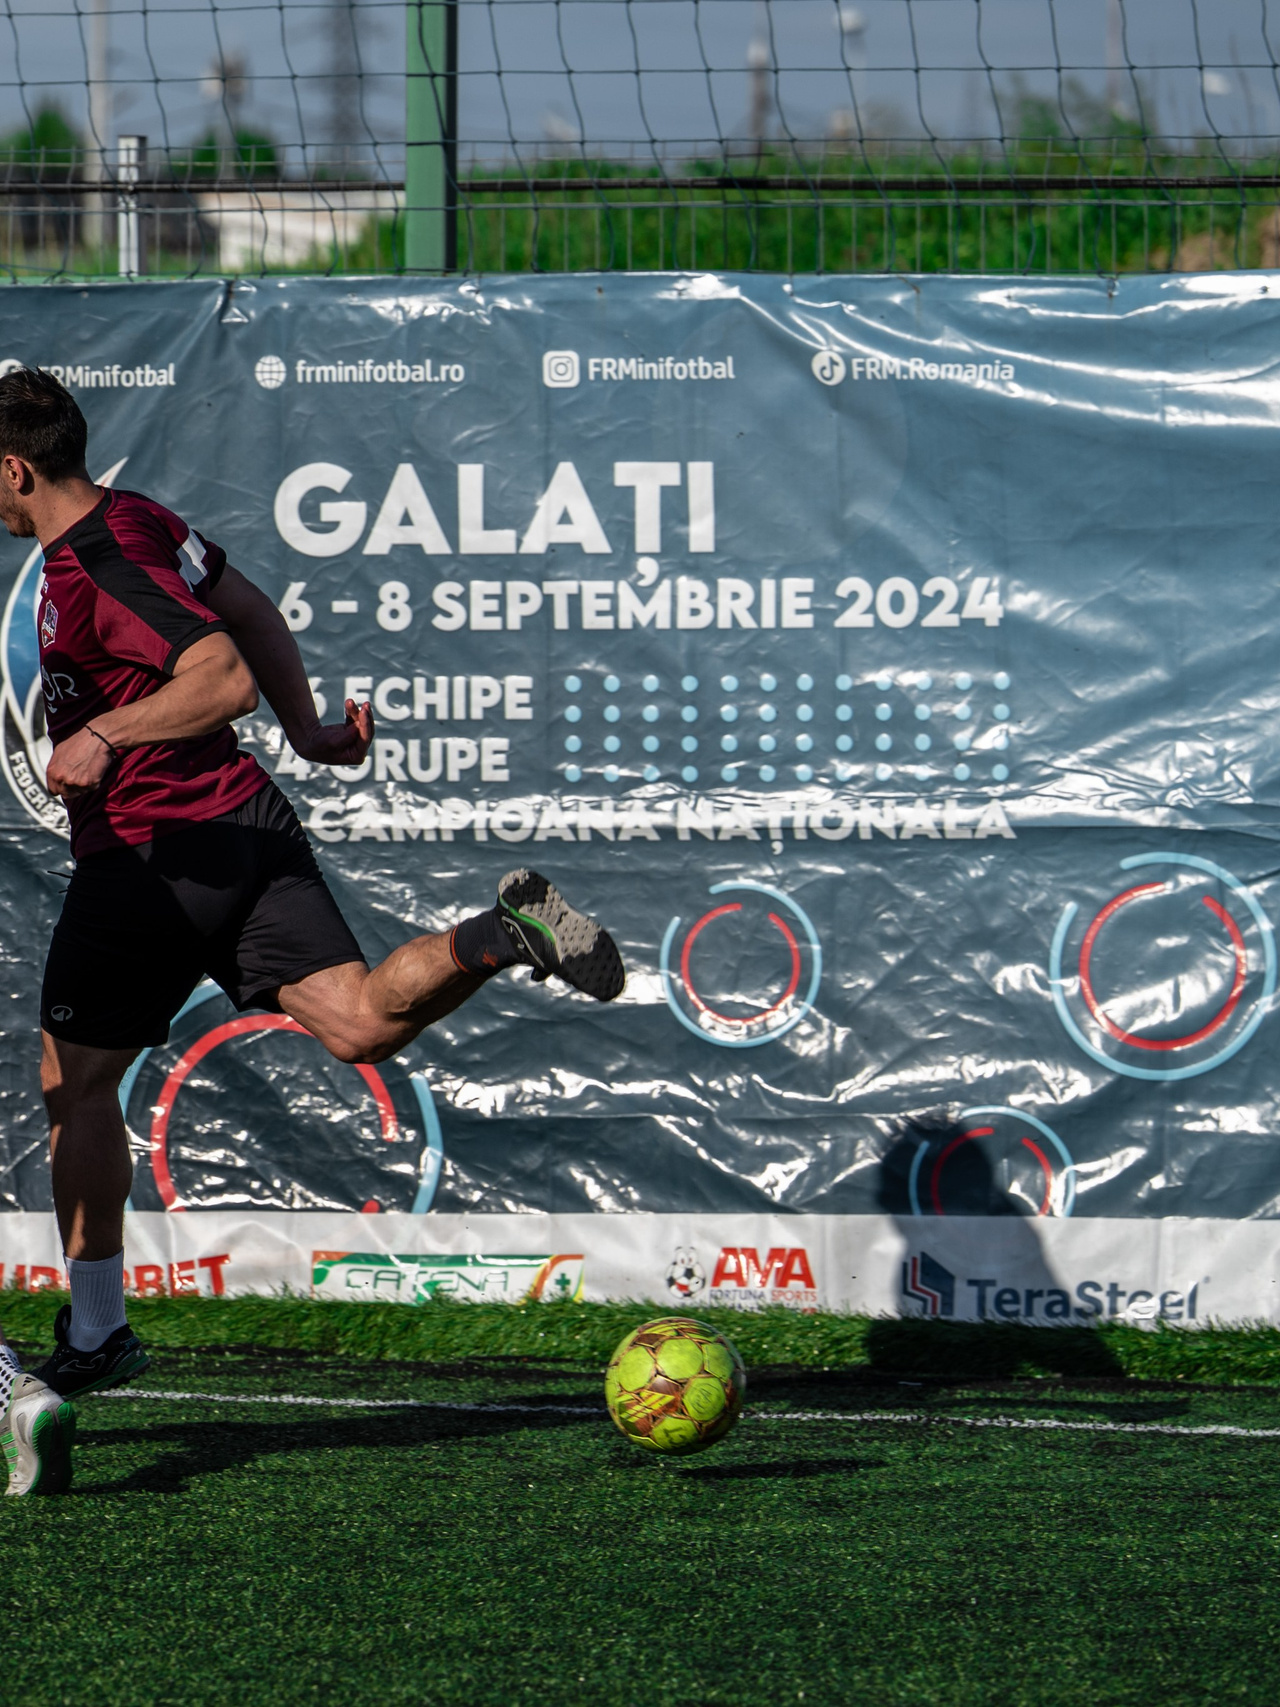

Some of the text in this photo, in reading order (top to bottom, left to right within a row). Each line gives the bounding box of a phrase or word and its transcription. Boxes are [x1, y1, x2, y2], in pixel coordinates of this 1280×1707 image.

[295, 359, 465, 383] frminifotbal.ro
[588, 356, 735, 381] FRMinifotbal
[851, 357, 1015, 381] FRM.Romania
[274, 461, 715, 587] GALAȚI
[278, 576, 1004, 632] 6 - 8 SEPTEMBRIE 2024
[308, 797, 662, 843] CAMPIOANA
[710, 1289, 817, 1301] FORTUNA SPORTS
[967, 1278, 1199, 1320] TeraSteel
